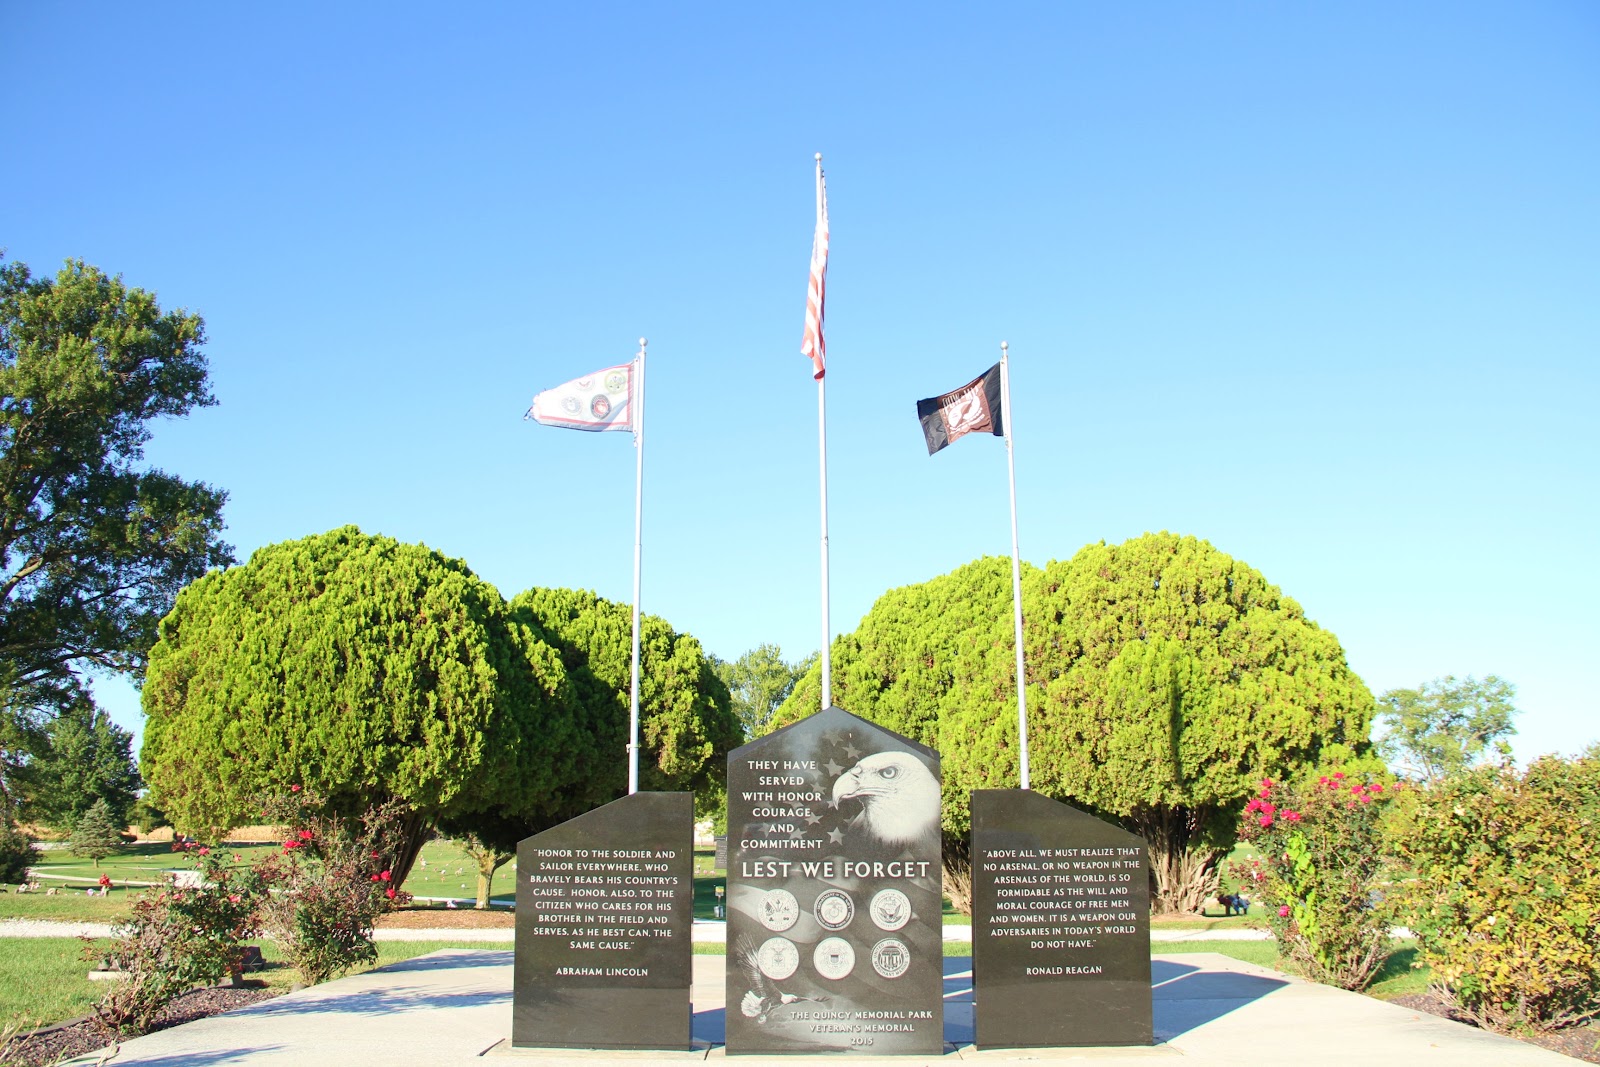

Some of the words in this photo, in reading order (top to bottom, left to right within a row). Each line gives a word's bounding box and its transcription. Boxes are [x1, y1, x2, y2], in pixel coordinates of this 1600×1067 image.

[748, 761, 779, 769] THEY
[784, 761, 816, 769] HAVE
[759, 776, 804, 785] SERVED
[742, 792, 772, 801] WITH
[778, 792, 821, 801] HONOR
[752, 808, 811, 817] COURAGE
[769, 824, 794, 832] AND
[741, 840, 823, 849] COMMITMENT
[592, 850, 609, 858] THE
[613, 850, 651, 858] SOLDIER
[655, 851, 675, 859] AND
[540, 862, 573, 871] SAILOR
[645, 864, 668, 872] WHO
[742, 862, 791, 878] LEST
[801, 862, 834, 878] WE
[844, 862, 930, 878] FORGET
[991, 928, 1049, 936] ADVERSARIES
[570, 941, 594, 949] SAME
[873, 943, 885, 958] UNITED
[897, 943, 909, 958] STATES
